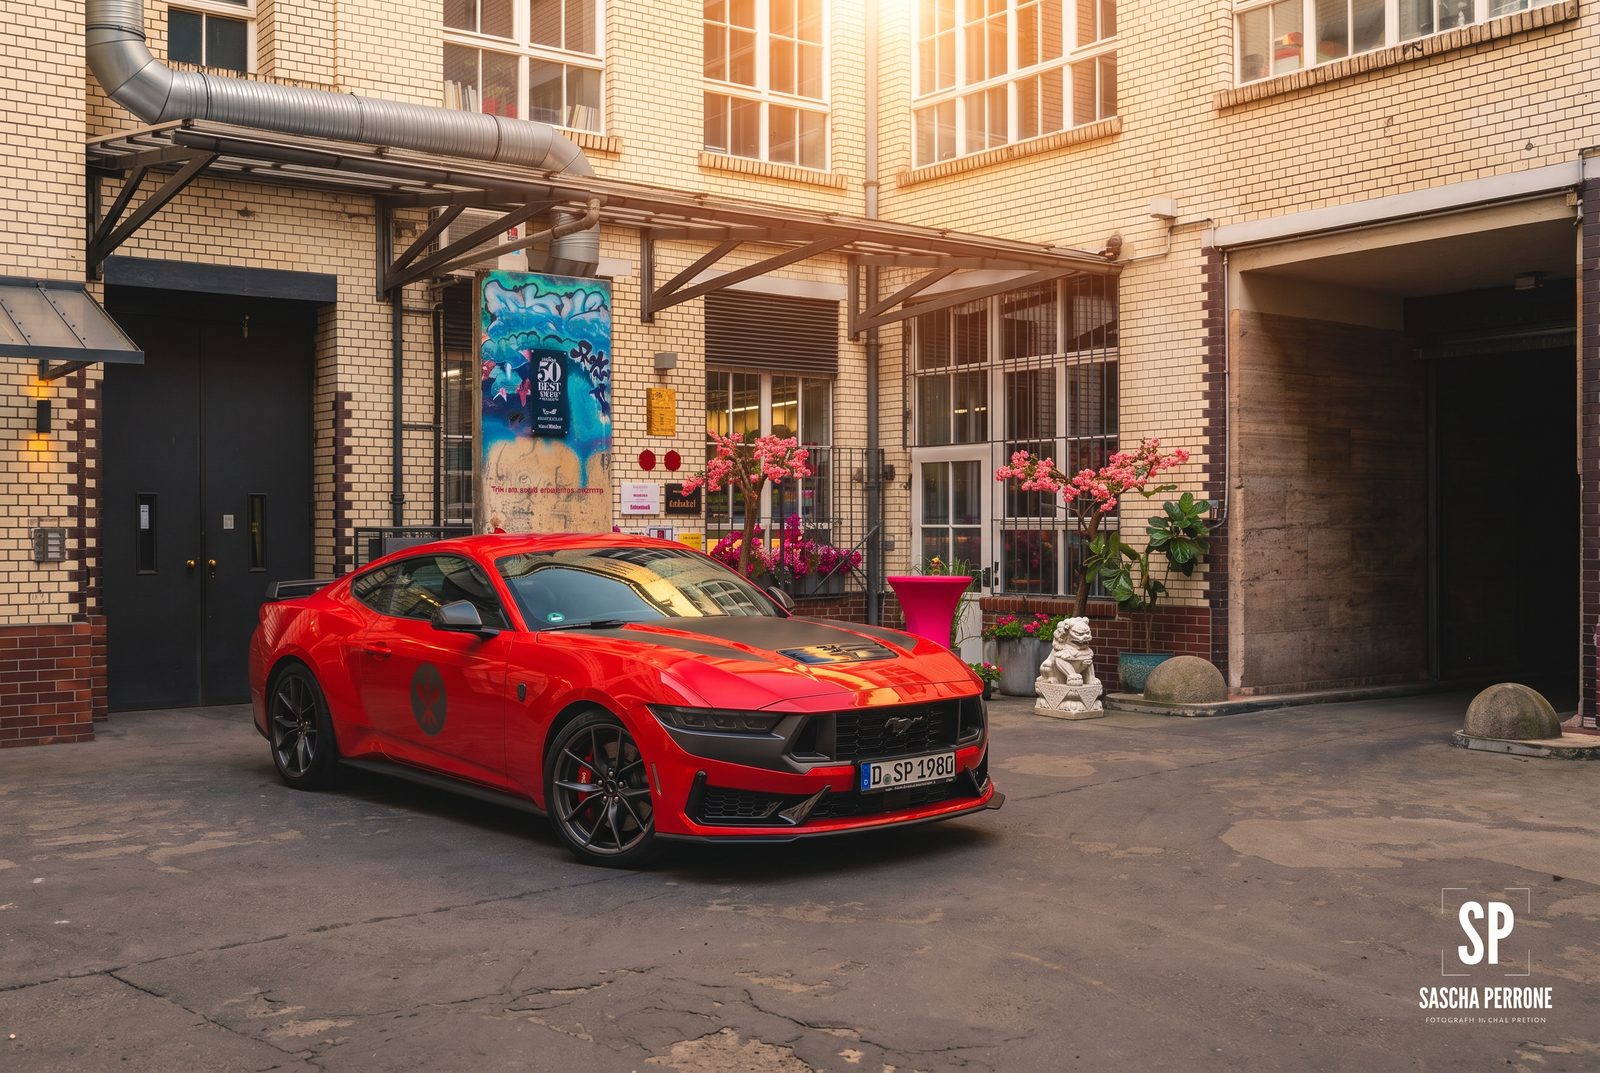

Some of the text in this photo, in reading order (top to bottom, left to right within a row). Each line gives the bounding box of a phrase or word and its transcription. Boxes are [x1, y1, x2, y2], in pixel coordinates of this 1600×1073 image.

[537, 361, 561, 382] 50
[538, 382, 561, 391] BEST
[872, 756, 953, 785] D SP 1980
